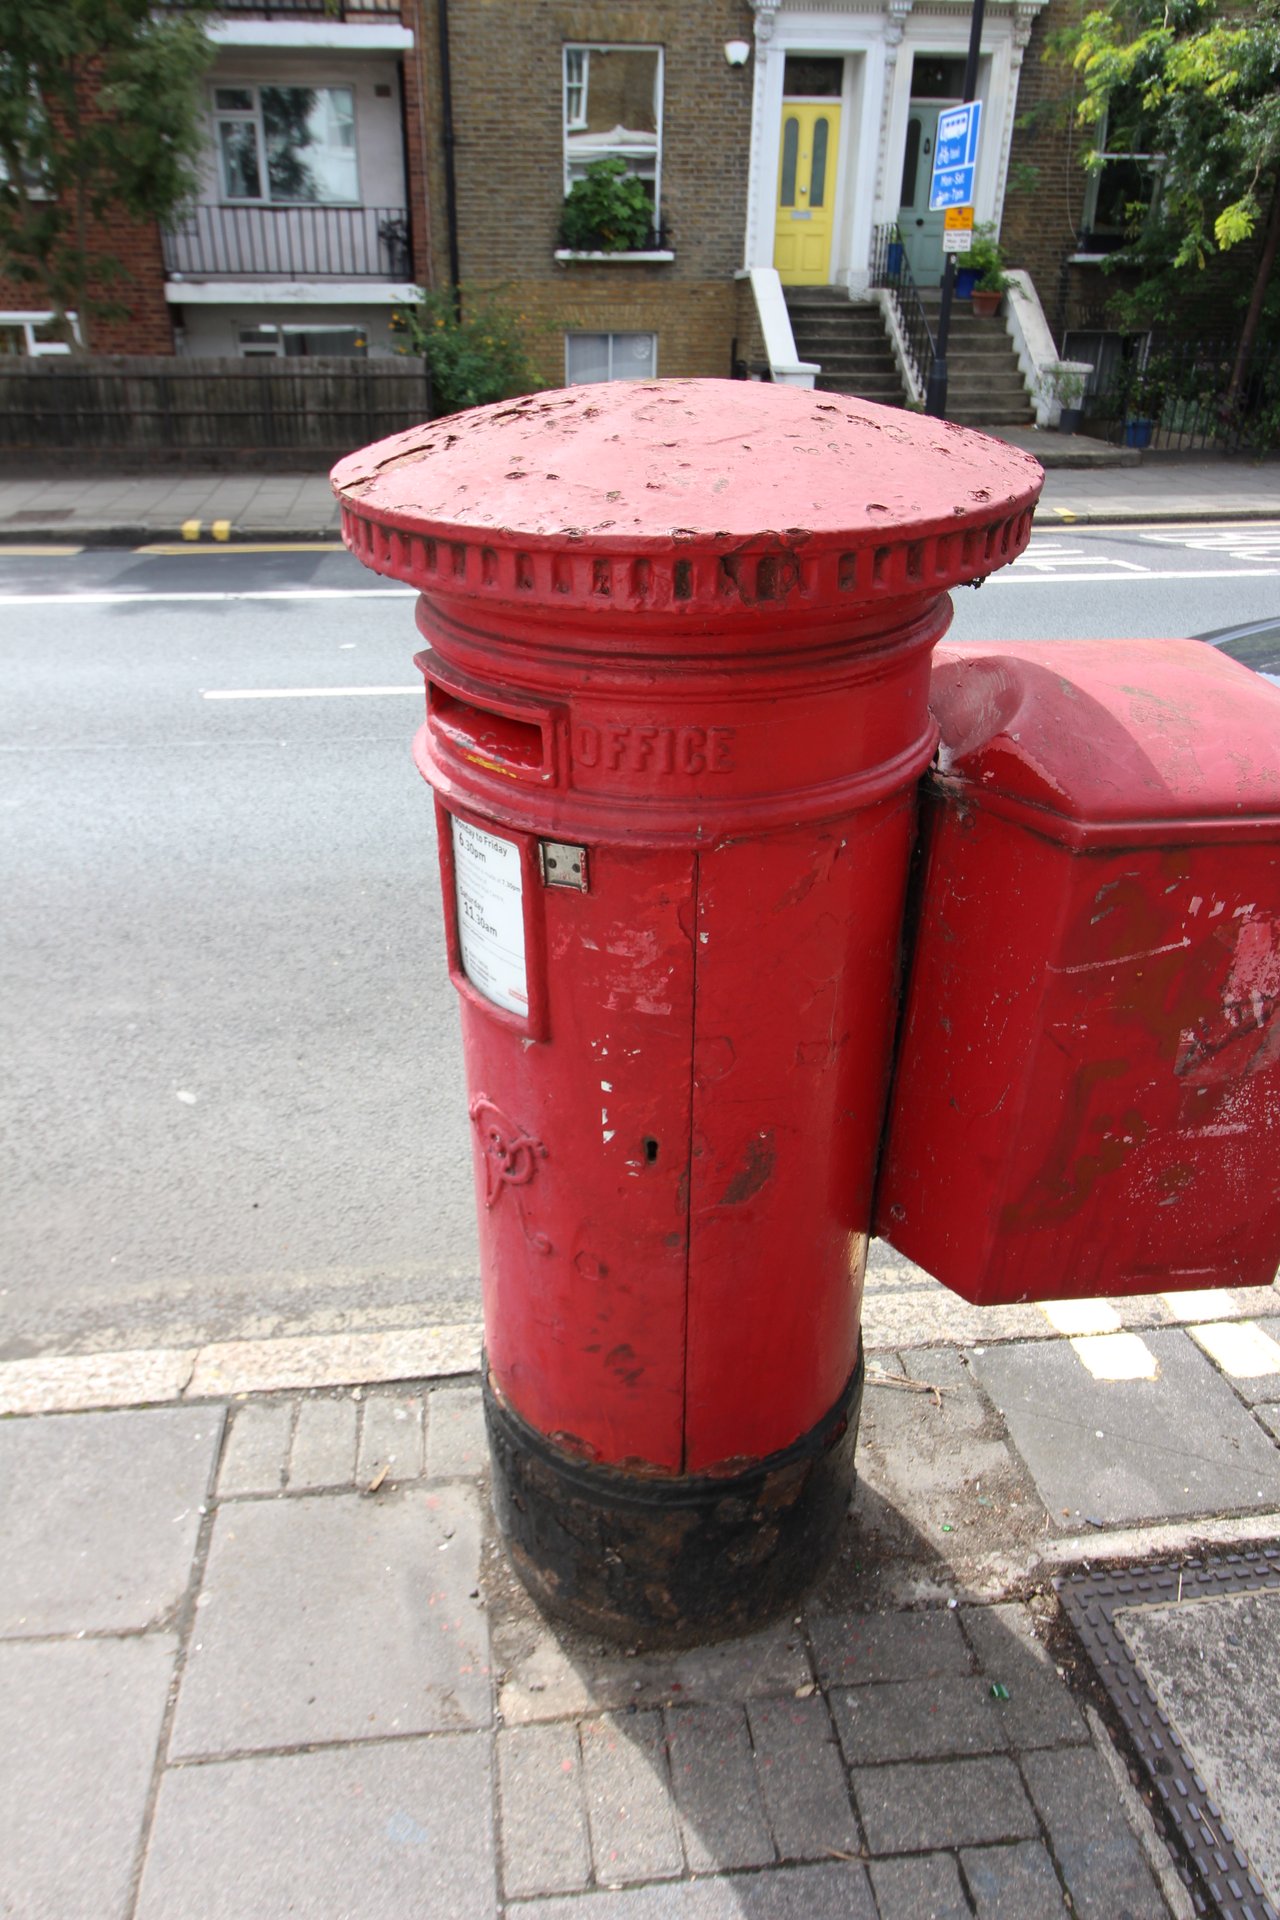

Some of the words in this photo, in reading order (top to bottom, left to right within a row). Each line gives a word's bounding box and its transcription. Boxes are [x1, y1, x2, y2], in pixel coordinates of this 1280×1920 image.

[572, 721, 737, 776] OFFICE
[475, 831, 483, 843] to
[484, 836, 508, 857] Friday
